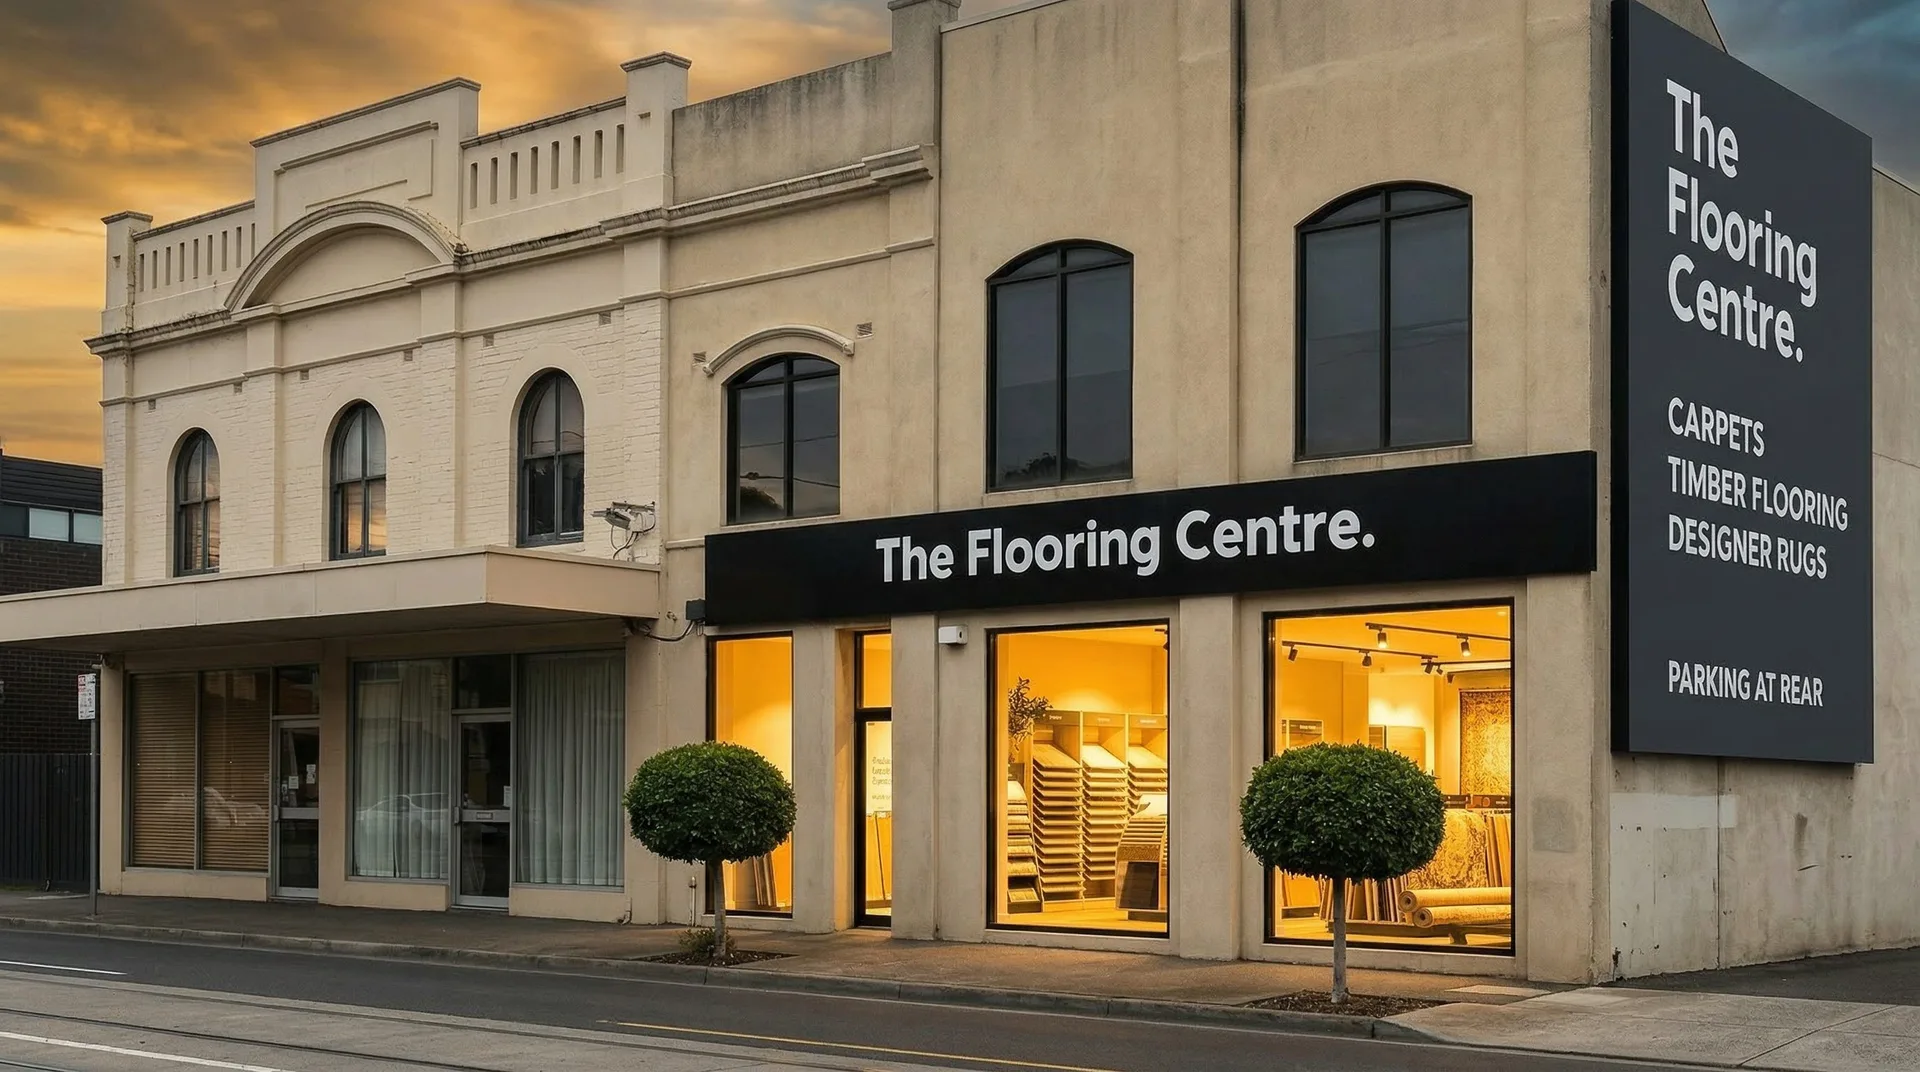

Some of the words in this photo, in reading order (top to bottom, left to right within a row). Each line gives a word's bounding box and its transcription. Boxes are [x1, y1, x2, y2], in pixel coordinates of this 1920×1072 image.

[1666, 79, 1739, 178] The
[1668, 166, 1817, 308] Flooring
[1668, 254, 1804, 363] Centre.
[1668, 397, 1765, 457] CARPETS
[1668, 455, 1747, 509] TIMBER
[1752, 476, 1848, 531] FLOORING
[875, 536, 954, 582] The
[967, 519, 1161, 577] Flooring
[1176, 505, 1375, 560] Centre.
[1668, 514, 1772, 568] DESIGNER
[1777, 536, 1827, 580] RUGS
[1668, 660, 1750, 701] PARKING
[1754, 671, 1777, 702] AT
[1780, 673, 1824, 707] REAR
